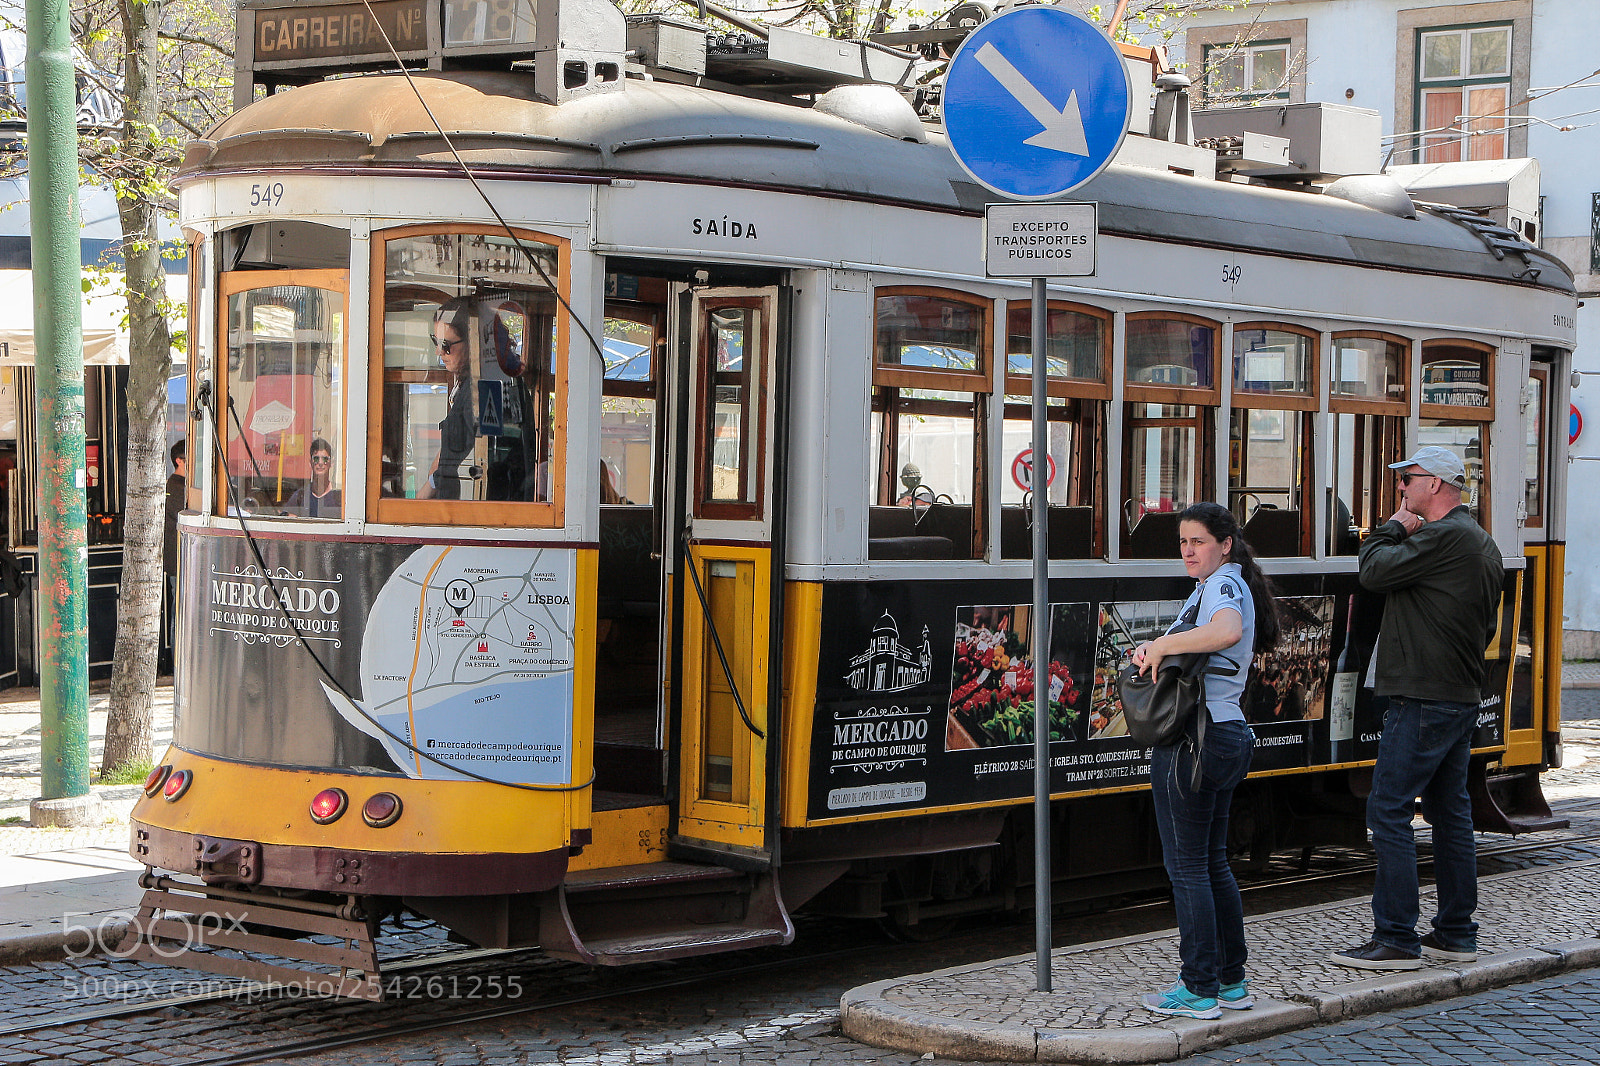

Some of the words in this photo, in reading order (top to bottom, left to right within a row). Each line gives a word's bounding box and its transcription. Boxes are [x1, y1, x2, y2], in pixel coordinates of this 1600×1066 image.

[260, 13, 384, 52] CARREIRA
[250, 183, 284, 207] 549
[692, 214, 758, 240] SAÍDA
[1012, 222, 1069, 232] EXCEPTO
[994, 235, 1087, 246] TRANSPORTES
[1008, 246, 1072, 259] PÚBLICOS
[1221, 264, 1242, 285] 549
[1453, 370, 1480, 378] CUIDADO
[211, 580, 340, 614] MERCADO
[527, 594, 570, 605] LISBOA
[211, 610, 224, 622] DE
[223, 612, 260, 627] CAMPO
[261, 615, 277, 628] DE
[508, 658, 529, 666] PRAÇA
[485, 693, 501, 702] TEJO
[832, 718, 928, 746] MERCADO
[1262, 733, 1304, 747] CONDESTÁVEL
[1376, 730, 1382, 740] S
[437, 740, 562, 753] mercadodecampodeourique
[831, 750, 844, 761] DE
[844, 747, 876, 760] CAMPO
[876, 746, 889, 757] DE
[889, 743, 927, 756] OURIQUE
[427, 752, 562, 764] mercadodecampodeourique.pt
[1054, 754, 1079, 767] IGREJA
[1079, 753, 1095, 765] STO.
[1095, 748, 1142, 763] CONDESTÁVEL
[973, 761, 1010, 775] ELÉTRICO
[1010, 760, 1019, 771] 28
[1019, 757, 1035, 771] SAÍD
[1065, 770, 1087, 782] TRAM
[1103, 766, 1129, 779] SORTEZ
[1137, 764, 1152, 775] IGRE
